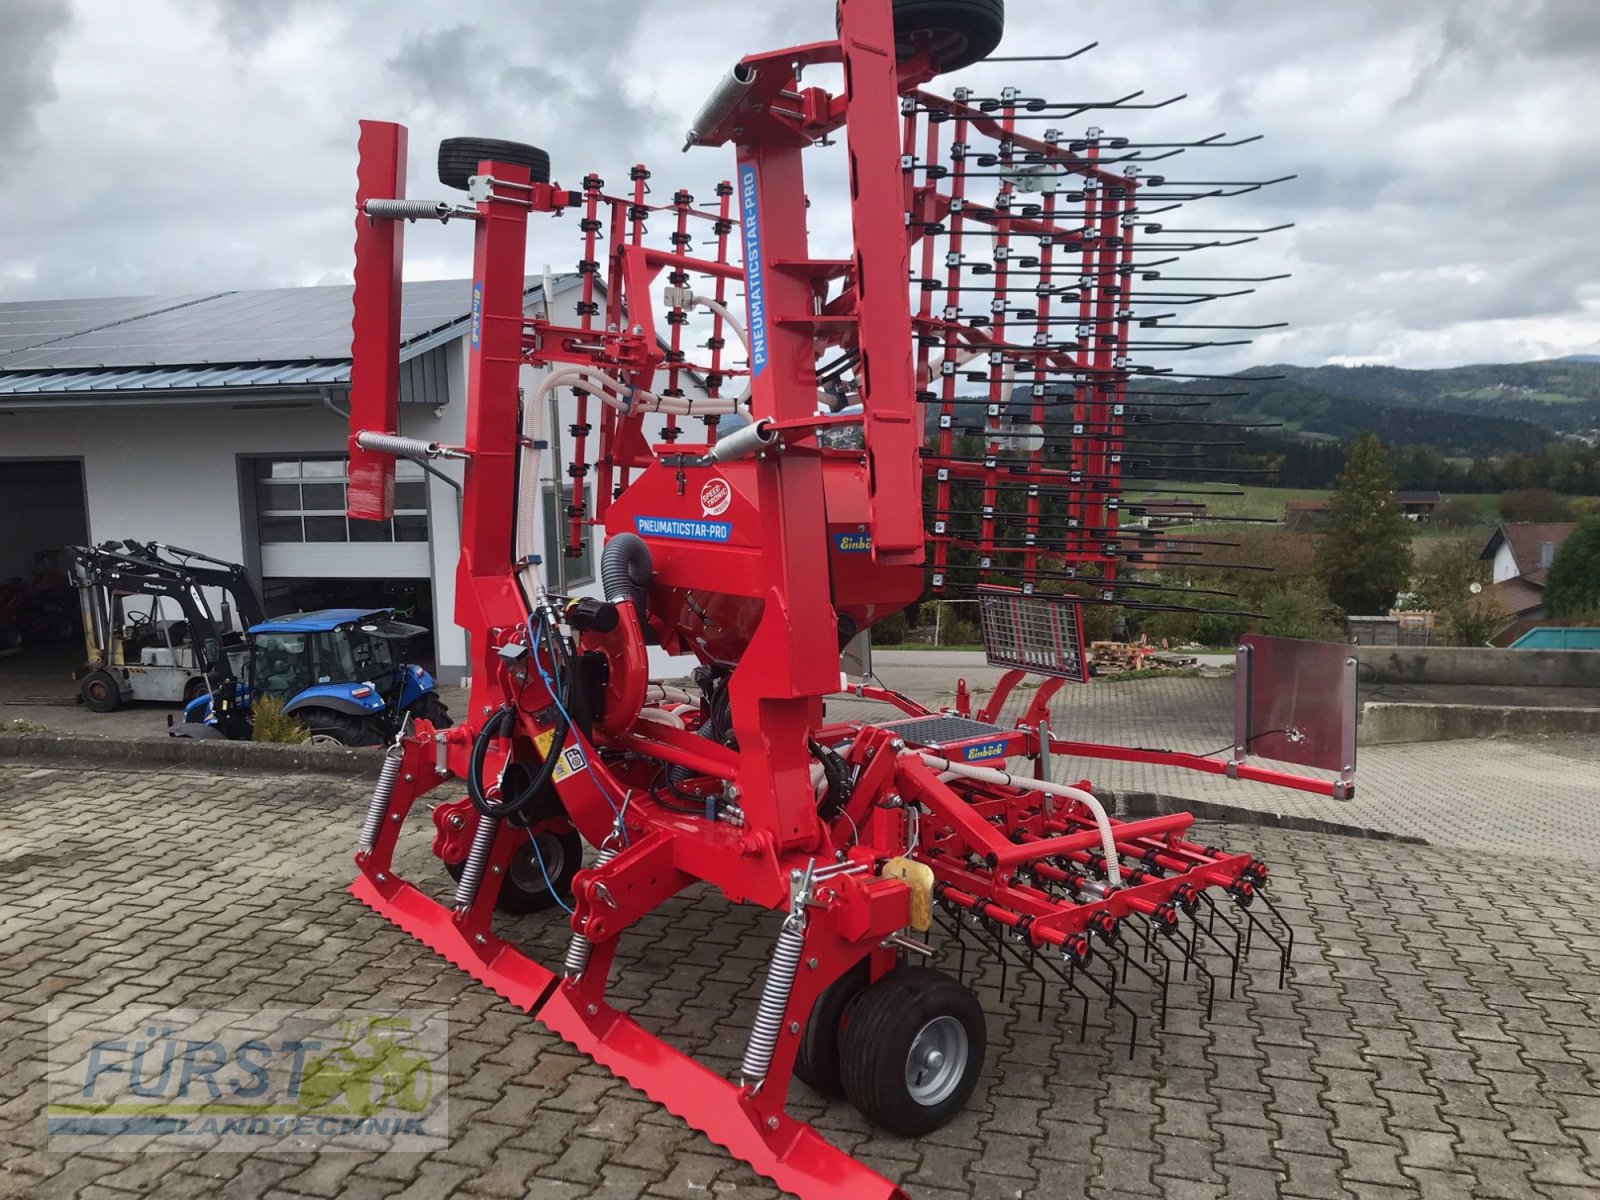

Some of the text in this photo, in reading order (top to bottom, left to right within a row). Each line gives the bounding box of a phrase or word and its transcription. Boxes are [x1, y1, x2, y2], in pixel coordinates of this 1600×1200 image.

[743, 172, 766, 365] PNEUMATICSTAR-PRO
[639, 519, 727, 539] PNEUMATICSTAR-PRO
[840, 536, 872, 550] Einbö
[968, 743, 1002, 760] Einböck
